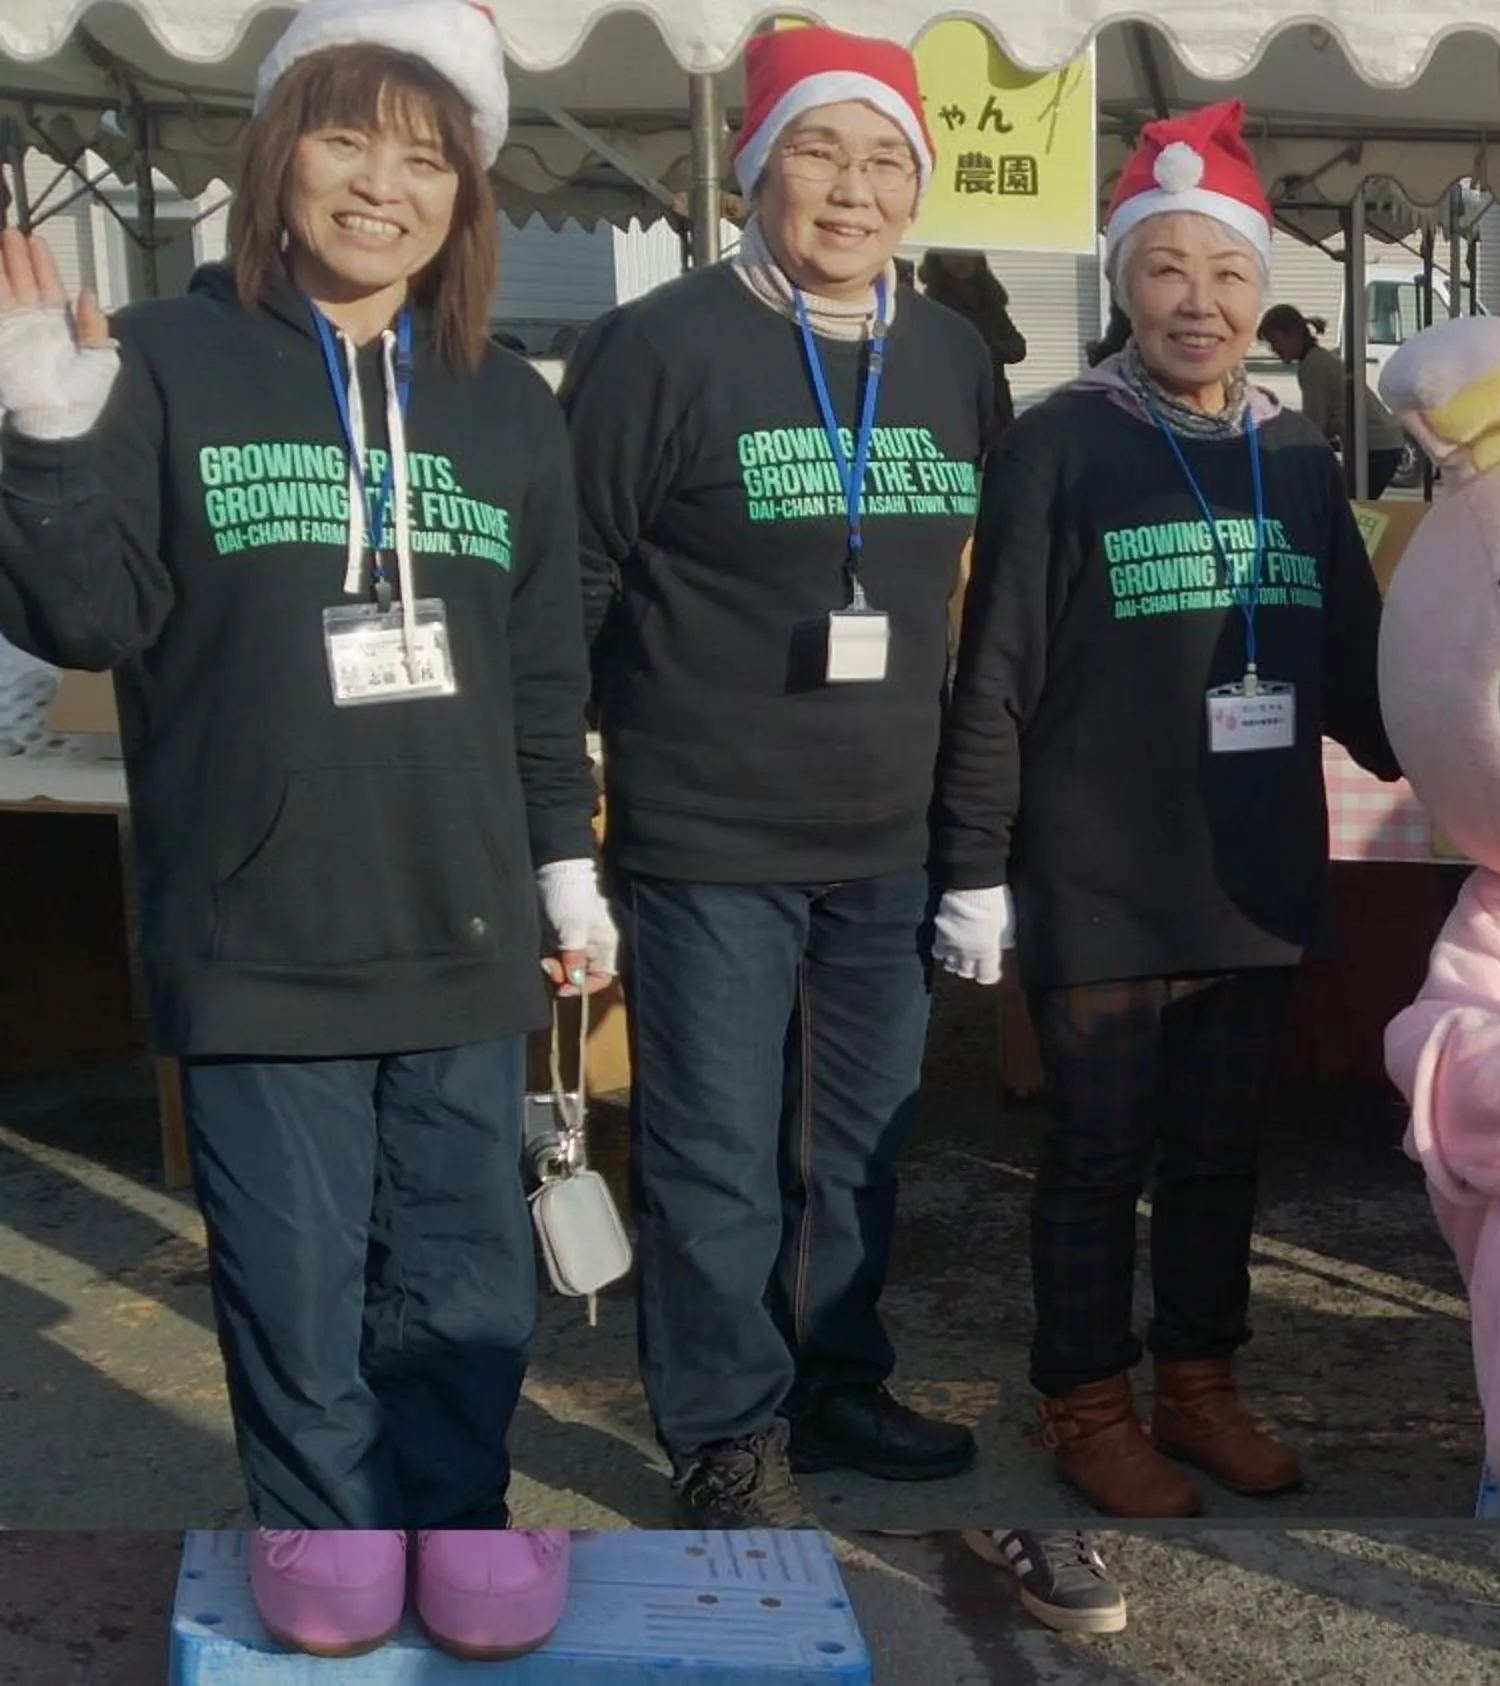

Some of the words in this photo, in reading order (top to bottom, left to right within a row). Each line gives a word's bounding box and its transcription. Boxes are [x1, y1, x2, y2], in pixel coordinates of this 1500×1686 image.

[937, 94, 1014, 134] ゃん
[954, 151, 1039, 196] 農園
[199, 443, 346, 486] GROWING
[361, 448, 463, 493] RITS.
[738, 427, 855, 467] GROWIG
[743, 461, 866, 498] GROWI
[866, 461, 918, 493] THE
[205, 481, 351, 529] GROWING
[749, 496, 825, 521] DAI-CHAN
[213, 519, 298, 556] DAI-CHAN
[300, 521, 347, 546] FARM
[410, 530, 457, 557] OWN,
[1103, 520, 1214, 563] GROWING
[1215, 518, 1291, 552] FRUTS.
[1109, 554, 1217, 598] GROWING
